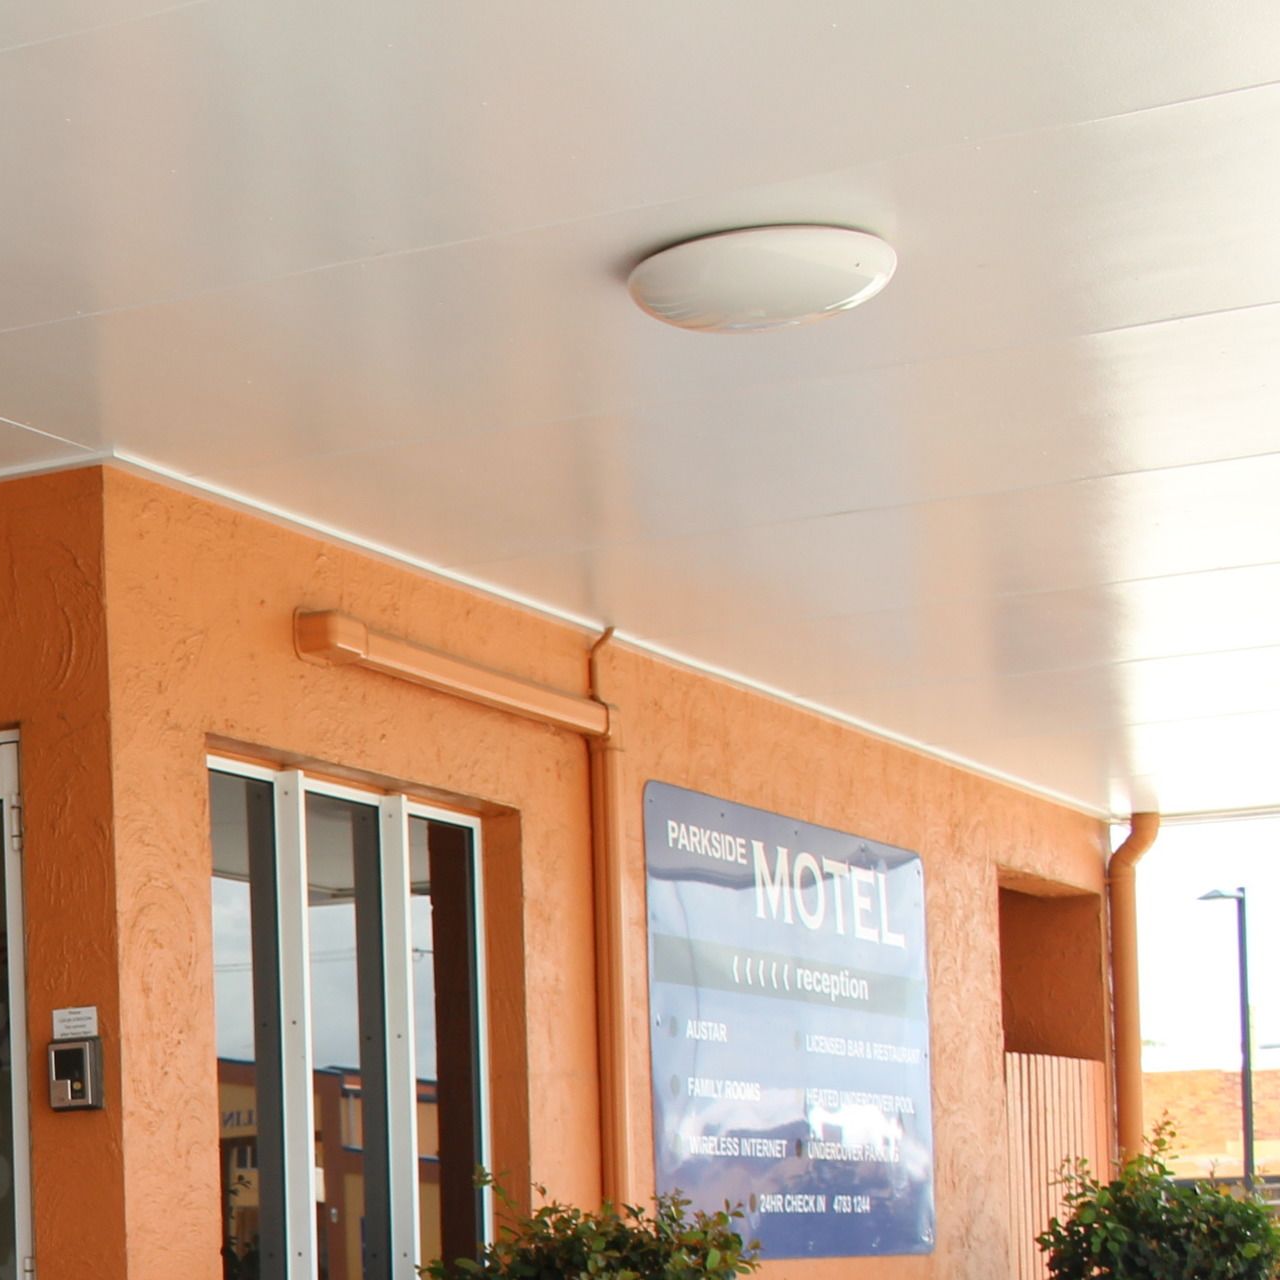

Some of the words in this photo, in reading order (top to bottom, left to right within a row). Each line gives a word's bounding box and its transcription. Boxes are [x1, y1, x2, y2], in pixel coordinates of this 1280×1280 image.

[667, 820, 748, 866] PARKSIDE
[751, 839, 906, 950] MOTEL
[796, 967, 870, 1003] reception
[686, 1018, 728, 1043] AUSTAR
[847, 1039, 865, 1059] BAR
[687, 1077, 724, 1099] FAMILY
[724, 1079, 761, 1102] ROOMS
[689, 1136, 739, 1156] WIRELESS
[741, 1138, 788, 1158] INTERNET
[760, 1193, 784, 1214] 24HR
[784, 1194, 816, 1214] CHECK
[817, 1194, 827, 1214] IN
